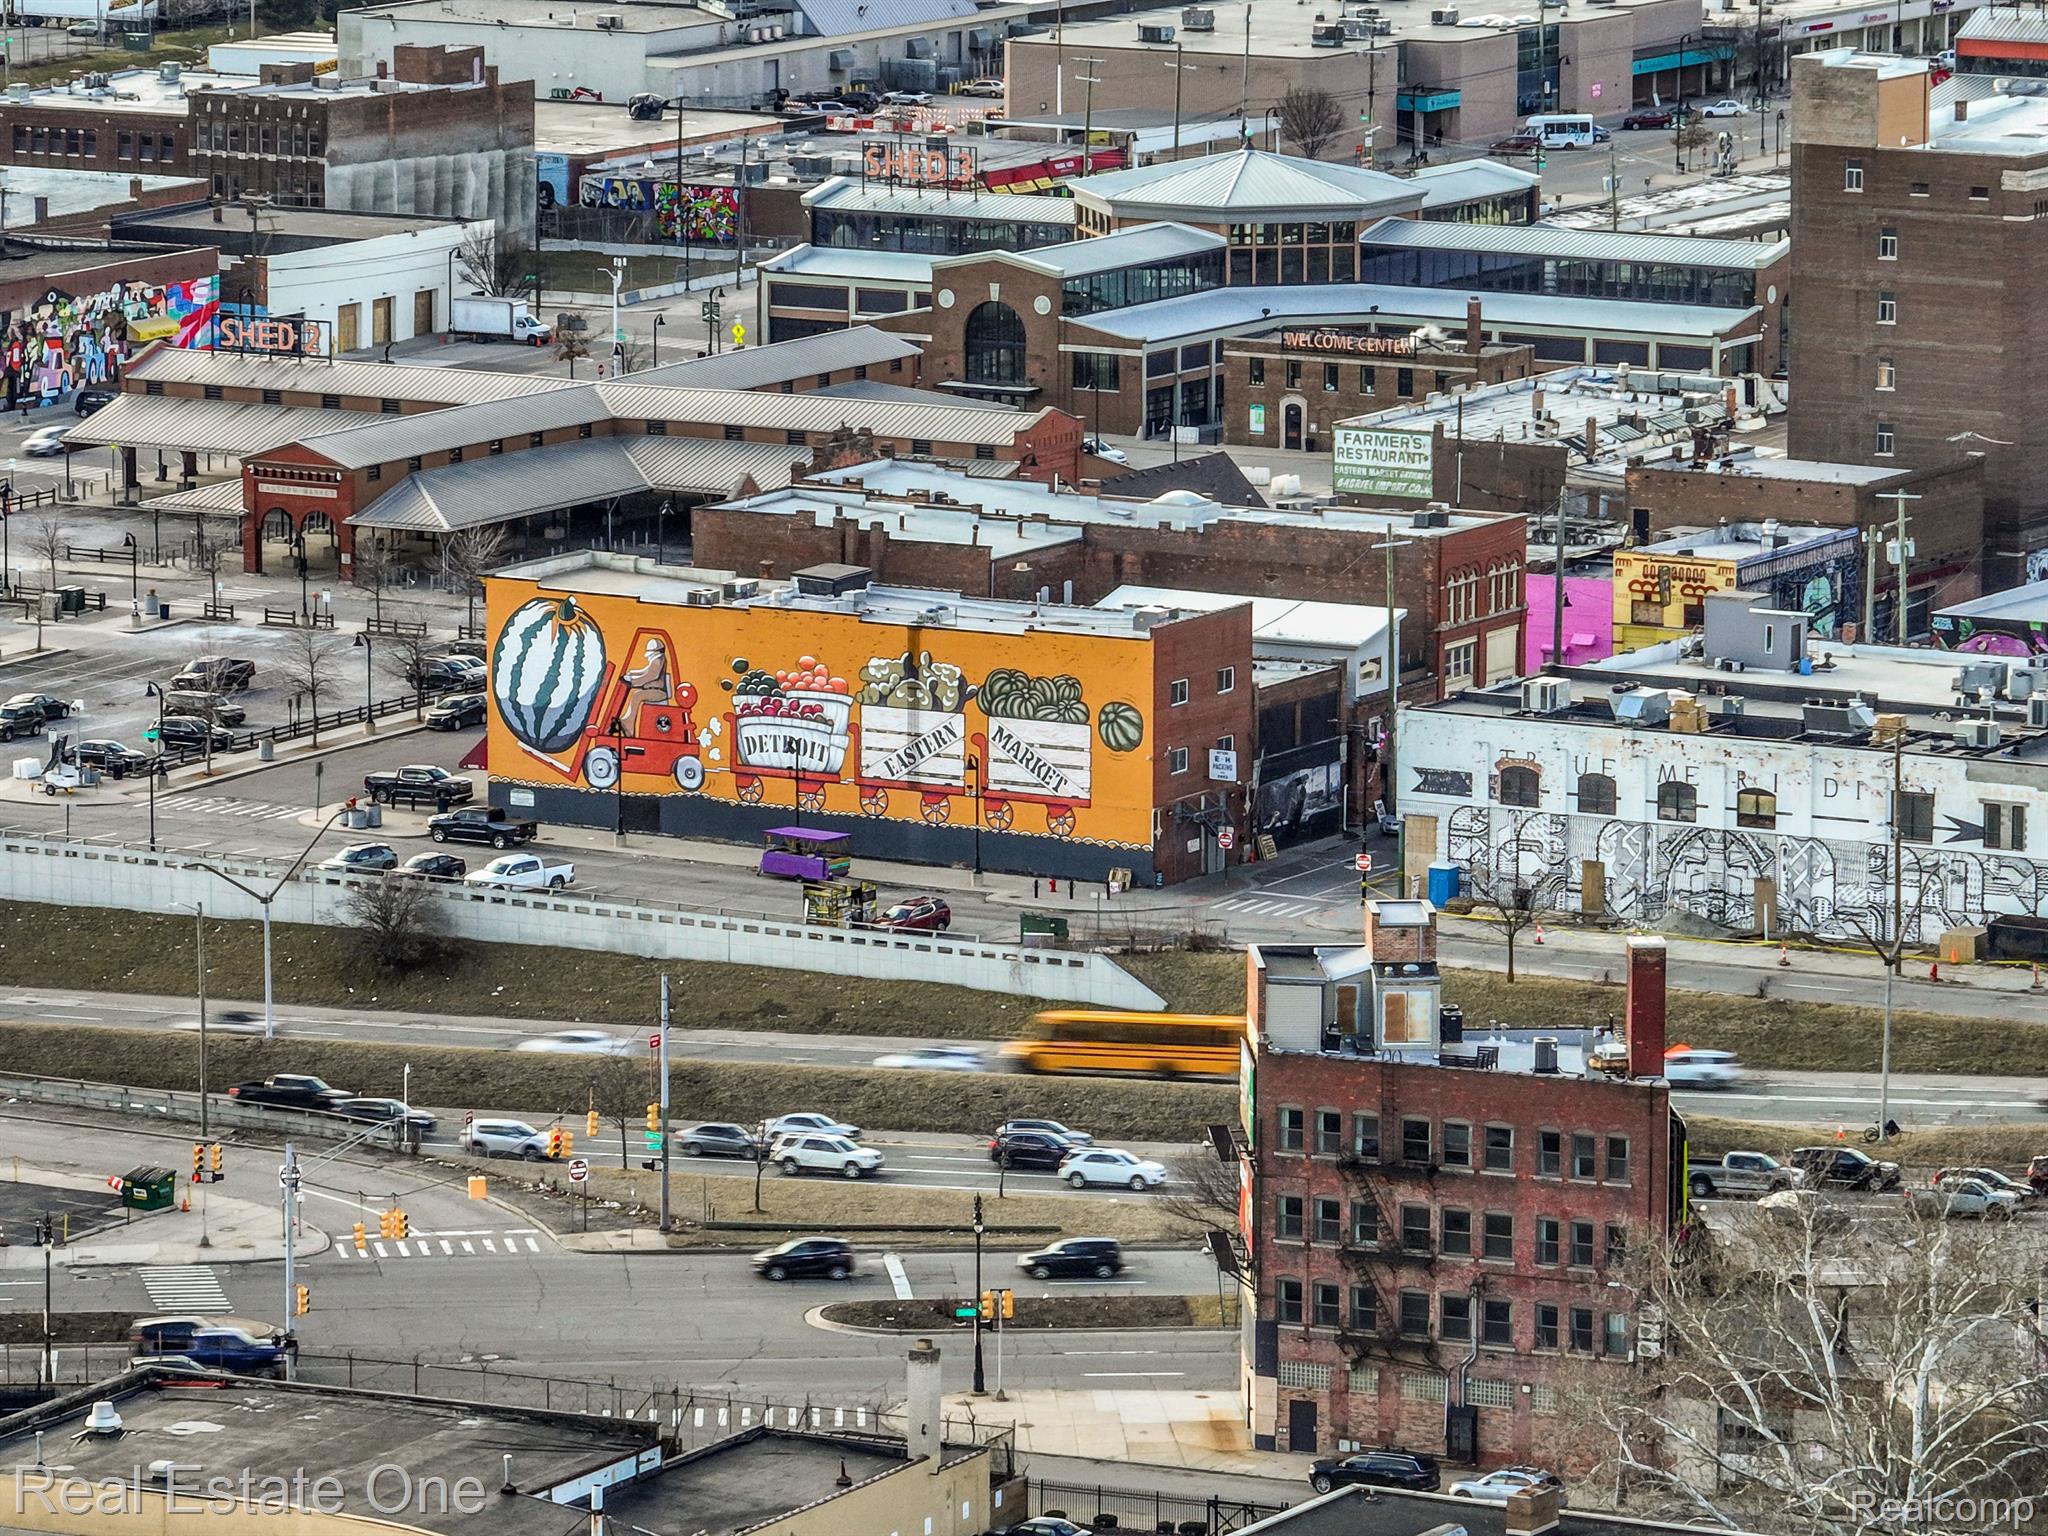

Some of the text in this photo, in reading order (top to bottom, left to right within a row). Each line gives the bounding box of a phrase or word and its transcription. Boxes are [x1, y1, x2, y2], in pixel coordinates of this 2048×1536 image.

[864, 147, 973, 181] SHED 3
[220, 318, 321, 353] SHED 2
[1283, 331, 1411, 354] WELCOME CENTER
[1343, 433, 1422, 449] FARMER'S
[1337, 447, 1424, 464] RESTAURANT
[1334, 464, 1367, 476] EASTERN
[1368, 467, 1399, 478] MARKET
[1336, 477, 1374, 490] GABRIEL
[1375, 480, 1407, 492] IMPORT
[744, 734, 829, 762] DETROIT
[882, 720, 960, 779] EASTERN
[990, 724, 1070, 795] MARKET
